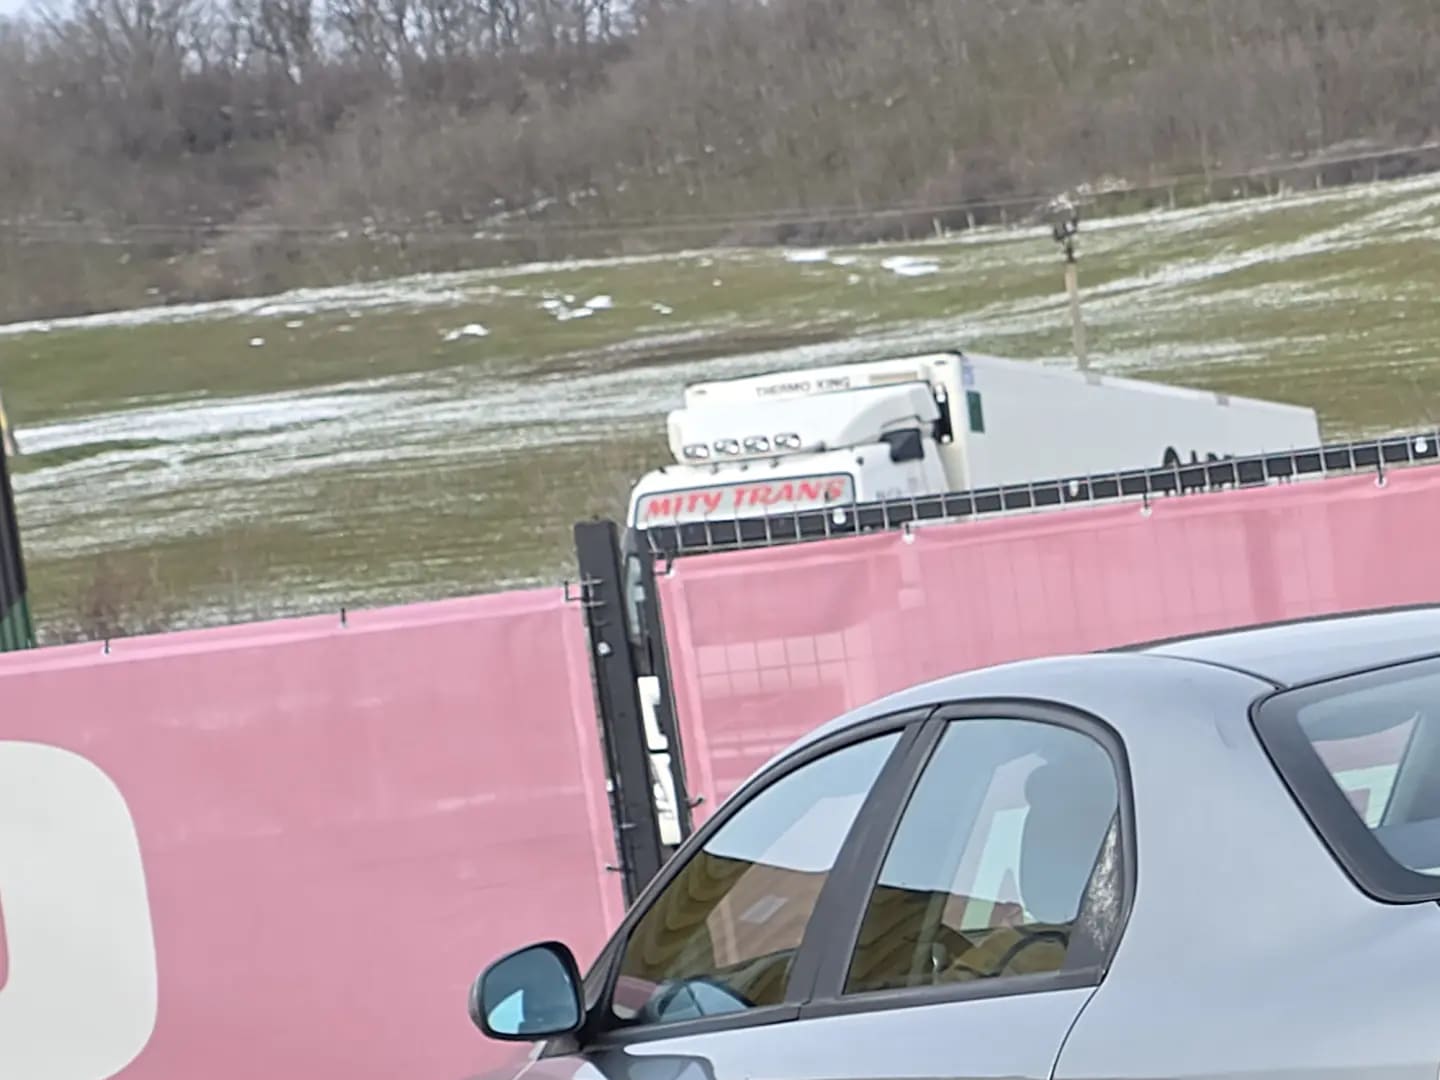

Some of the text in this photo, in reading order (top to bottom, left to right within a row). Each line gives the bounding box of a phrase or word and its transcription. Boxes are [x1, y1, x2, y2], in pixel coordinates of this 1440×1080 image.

[755, 376, 851, 398] THERMO KING
[644, 491, 723, 517] MITY
[733, 477, 848, 508] TRANS
